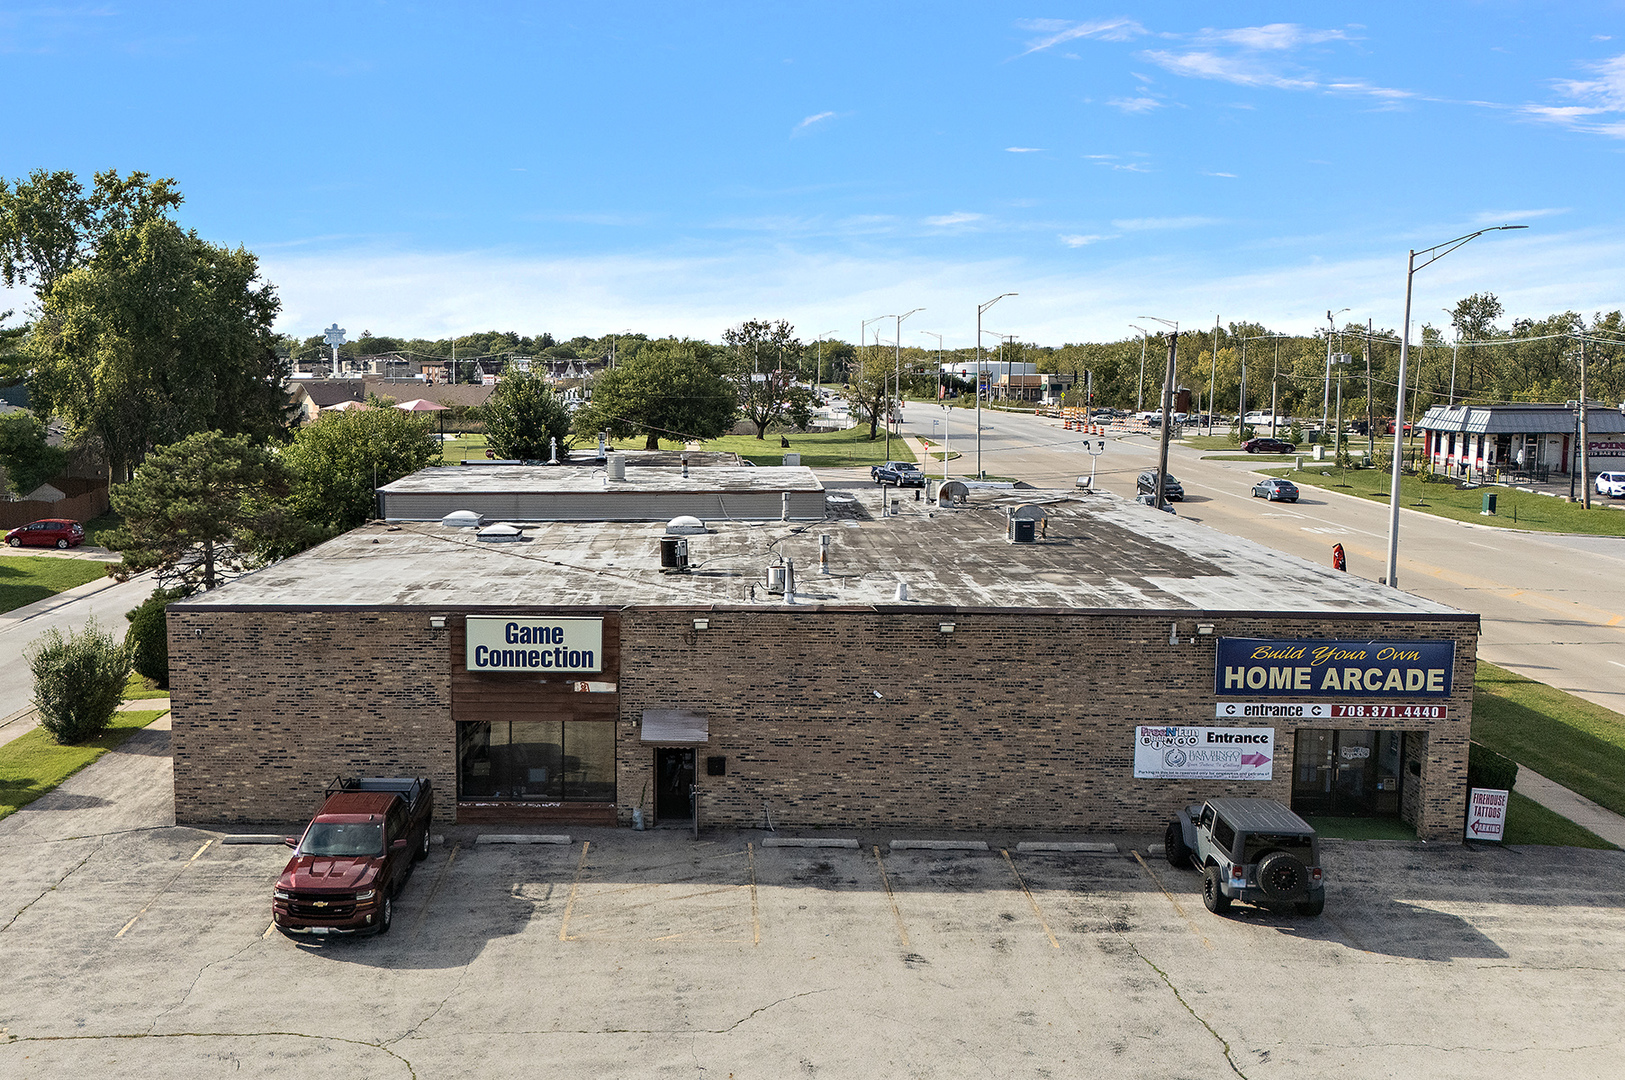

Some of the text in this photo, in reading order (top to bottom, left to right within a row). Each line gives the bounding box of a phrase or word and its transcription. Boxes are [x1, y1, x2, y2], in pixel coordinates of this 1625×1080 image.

[505, 622, 564, 645] Game
[475, 645, 594, 668] Connection
[1250, 646, 1421, 666] Build Your Own
[1224, 666, 1445, 692] HOME ARCADE
[1244, 704, 1439, 718] entrance 708.371.4440
[1143, 737, 1197, 748] BINGO
[1206, 731, 1269, 744] Entrance
[1473, 793, 1505, 806] FIREHOUSE
[1474, 806, 1501, 818] TATTOOS
